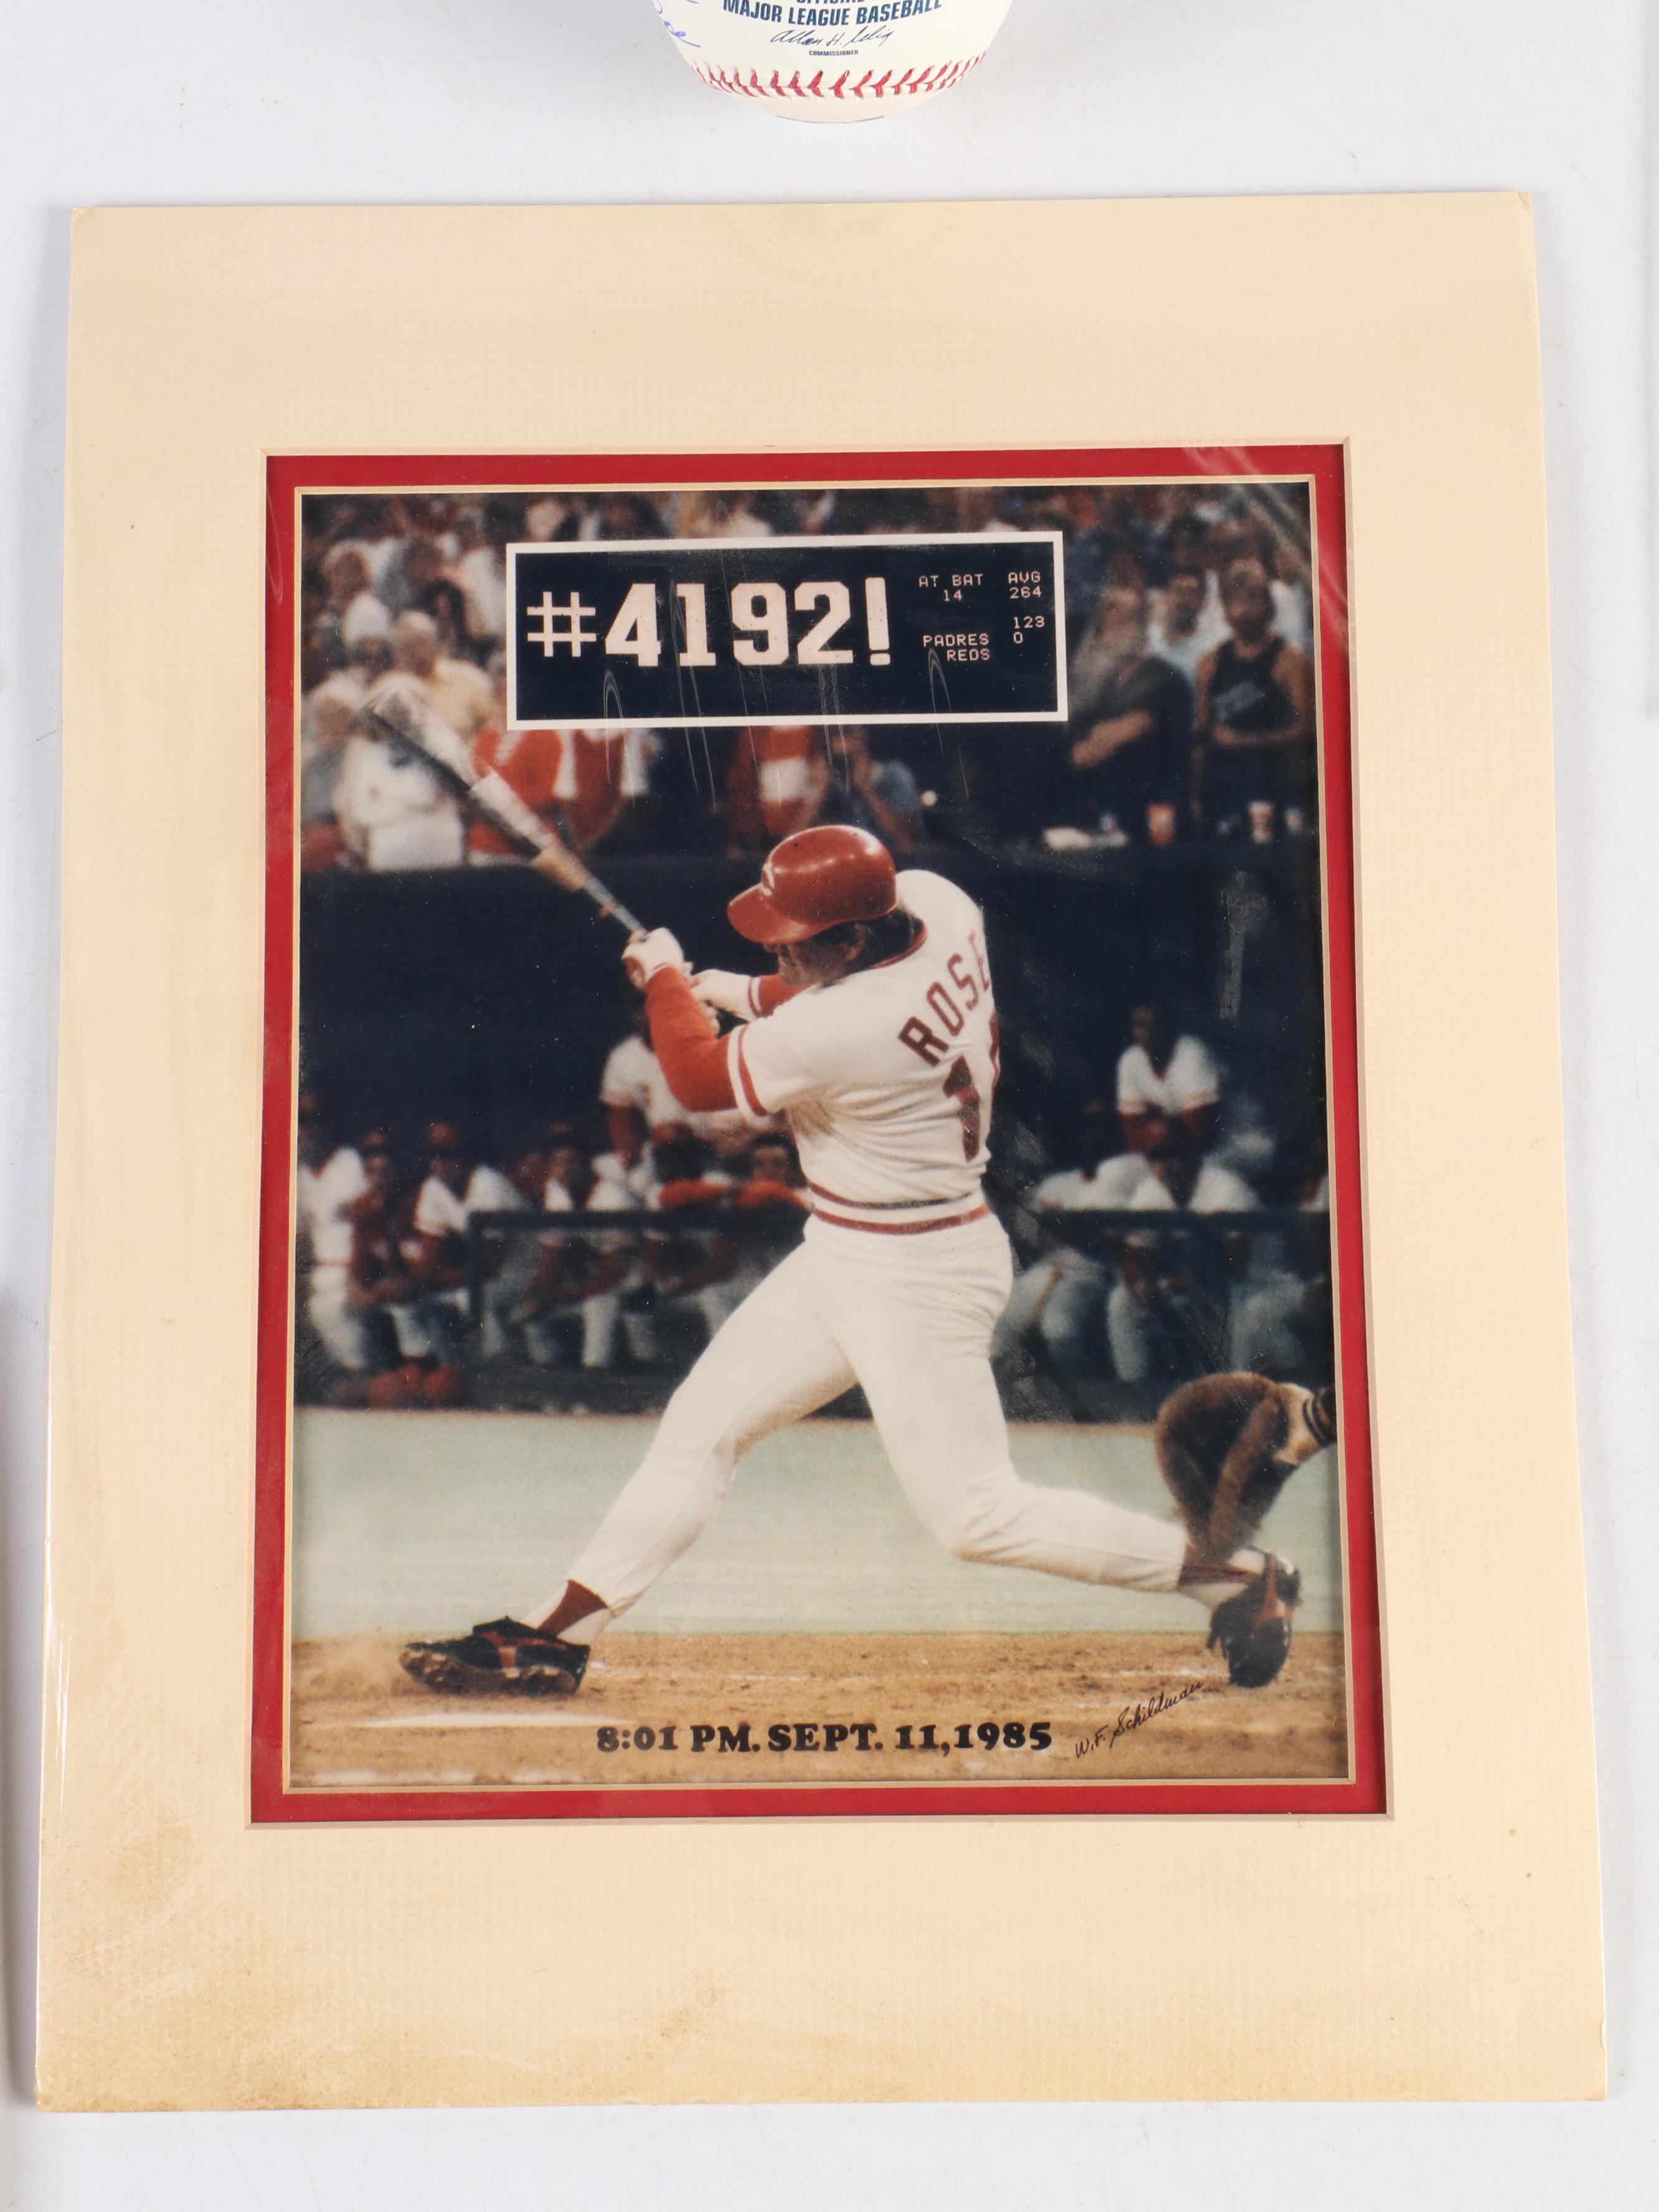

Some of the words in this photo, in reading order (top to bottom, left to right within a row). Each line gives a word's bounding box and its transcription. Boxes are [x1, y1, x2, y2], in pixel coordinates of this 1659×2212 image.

[723, 0, 782, 23] MAJOR
[788, 7, 851, 26] LEAGUE
[856, 0, 942, 24] BASEBALL
[919, 575, 938, 588] AT
[952, 574, 983, 587] BAT
[1008, 571, 1041, 585] AVG
[943, 589, 963, 602] 14
[1009, 585, 1042, 599] 264
[527, 577, 891, 667] #4192!
[1013, 615, 1045, 629] 123
[922, 633, 990, 648] PADRES
[597, 1726, 678, 1752] 8:01
